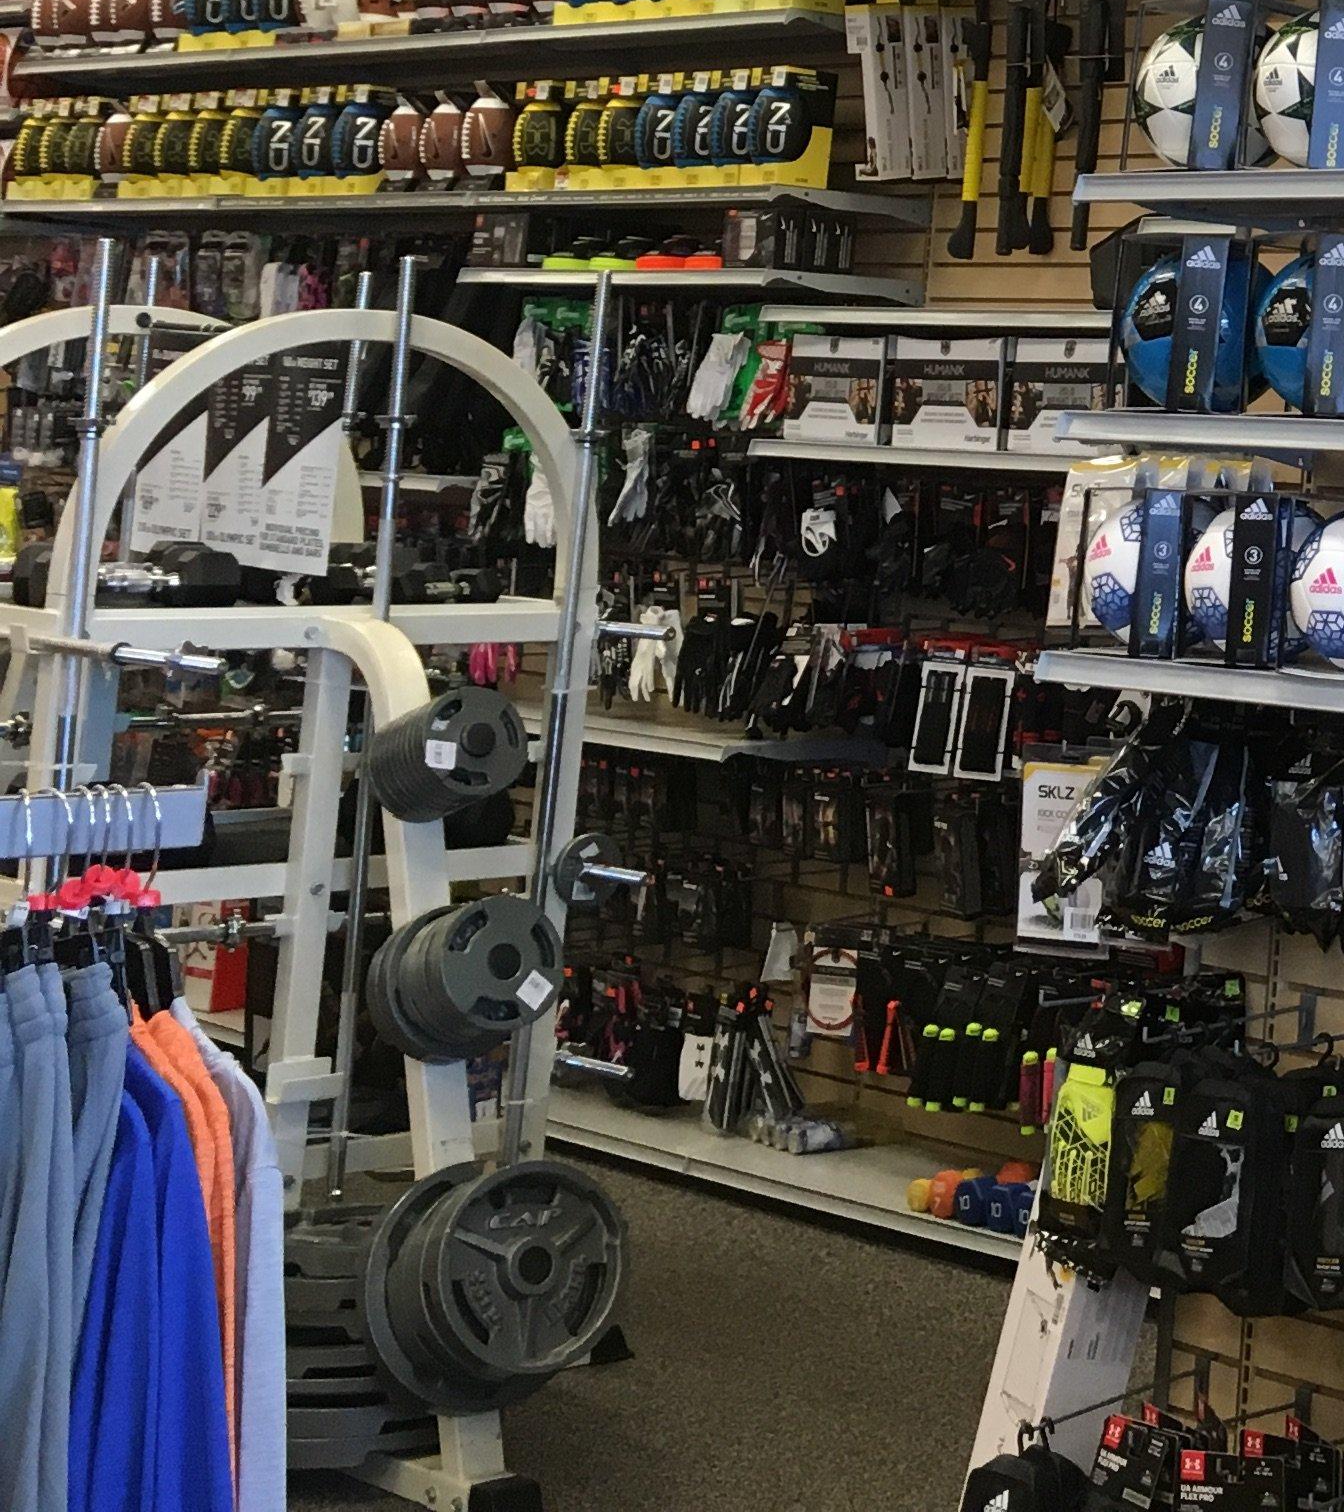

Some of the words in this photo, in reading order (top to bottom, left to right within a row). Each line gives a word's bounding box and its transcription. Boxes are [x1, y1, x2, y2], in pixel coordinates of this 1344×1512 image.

[1212, 18, 1246, 28] adidas
[1326, 123, 1339, 168] soccer
[1186, 259, 1221, 270] adidas
[1320, 349, 1334, 396] soccer
[1150, 592, 1162, 634] soccer
[1038, 785, 1074, 800] SKLZ
